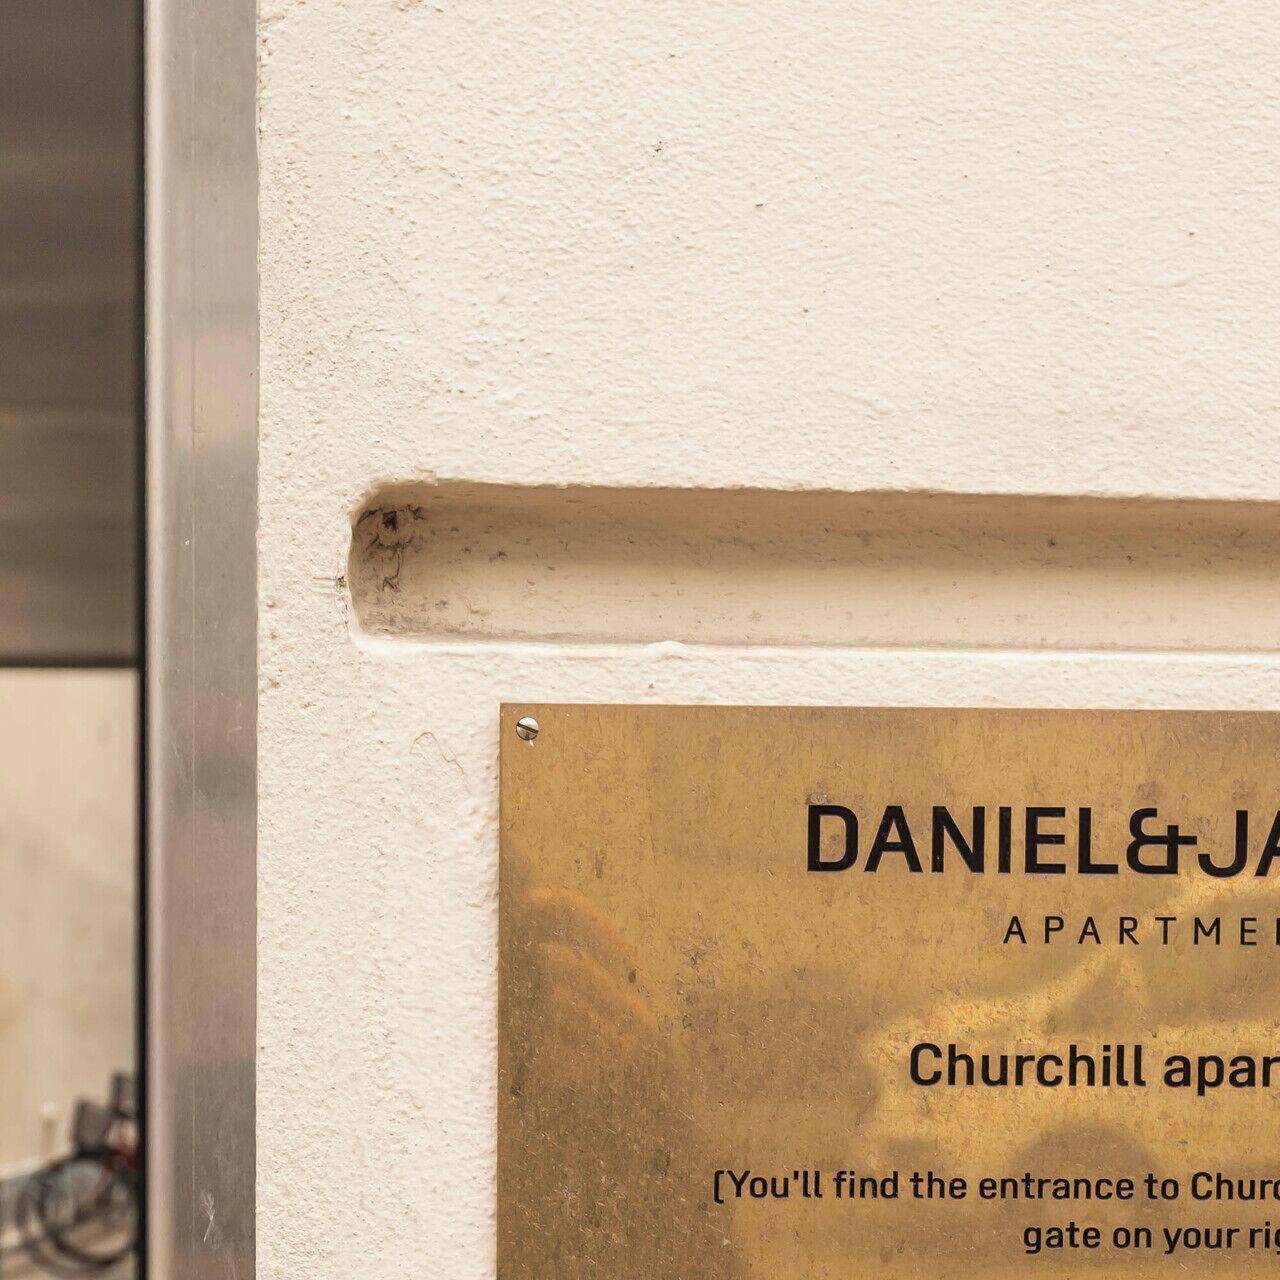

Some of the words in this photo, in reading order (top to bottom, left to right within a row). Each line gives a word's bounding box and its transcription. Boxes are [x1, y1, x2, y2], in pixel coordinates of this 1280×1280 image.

[910, 1042, 1146, 1087] Churchill
[832, 1170, 899, 1199] find
[909, 1170, 967, 1200] the
[979, 1172, 1134, 1201] entrance
[1143, 1172, 1179, 1200] to
[1023, 1221, 1101, 1255] gate
[1112, 1227, 1152, 1249] on
[1162, 1227, 1241, 1255] your
